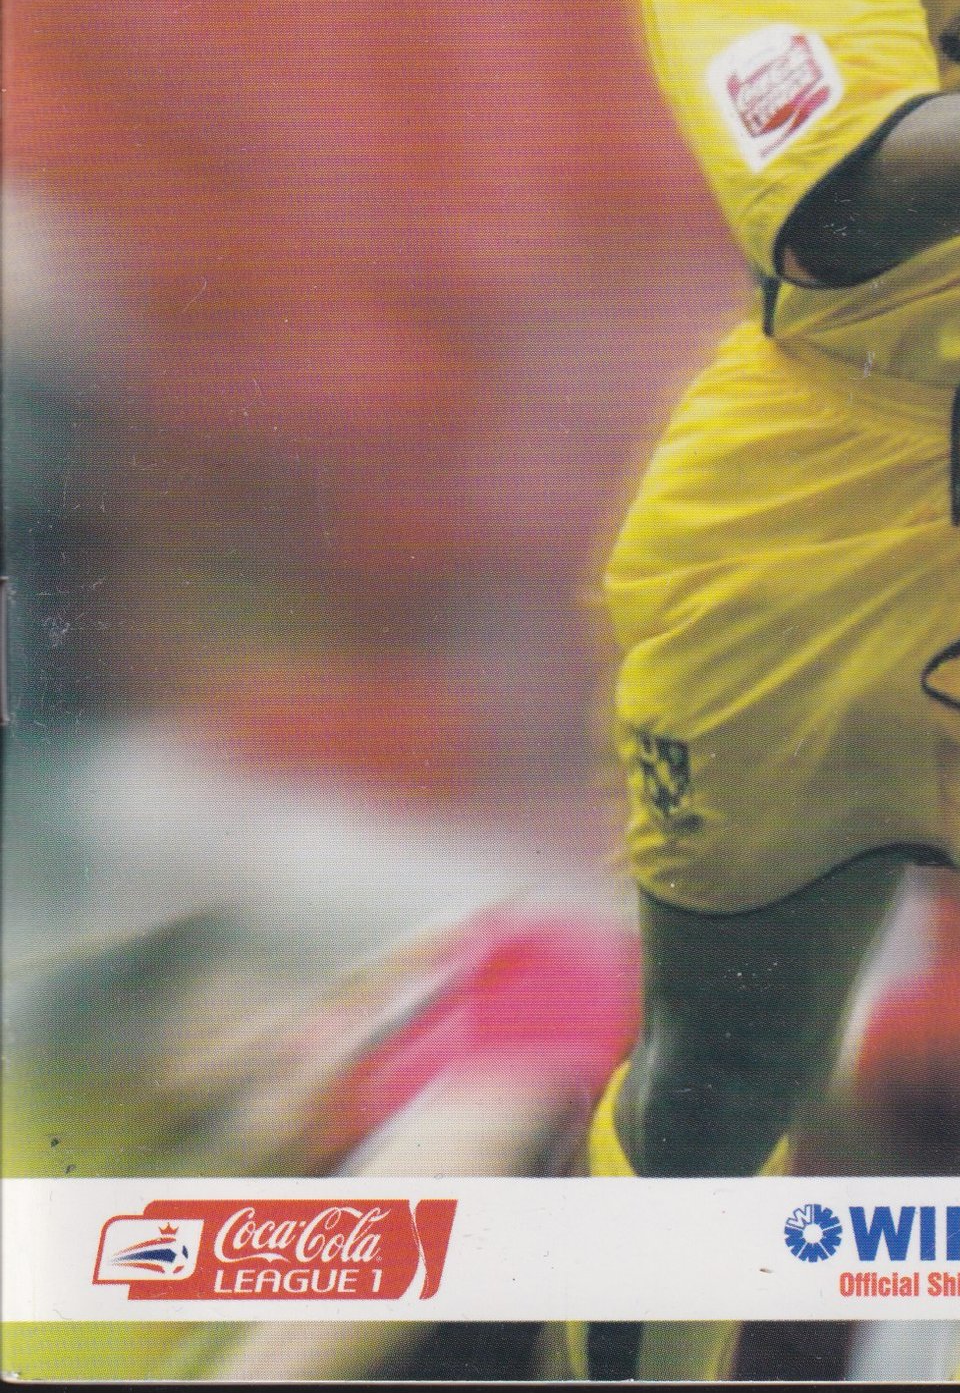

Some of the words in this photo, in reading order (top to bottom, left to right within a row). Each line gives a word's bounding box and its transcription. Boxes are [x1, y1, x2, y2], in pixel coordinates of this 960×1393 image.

[213, 1207, 391, 1263] Coca-Cola
[214, 1269, 359, 1293] LEAGUE
[370, 1268, 383, 1293] 1
[839, 1271, 920, 1297] Official
